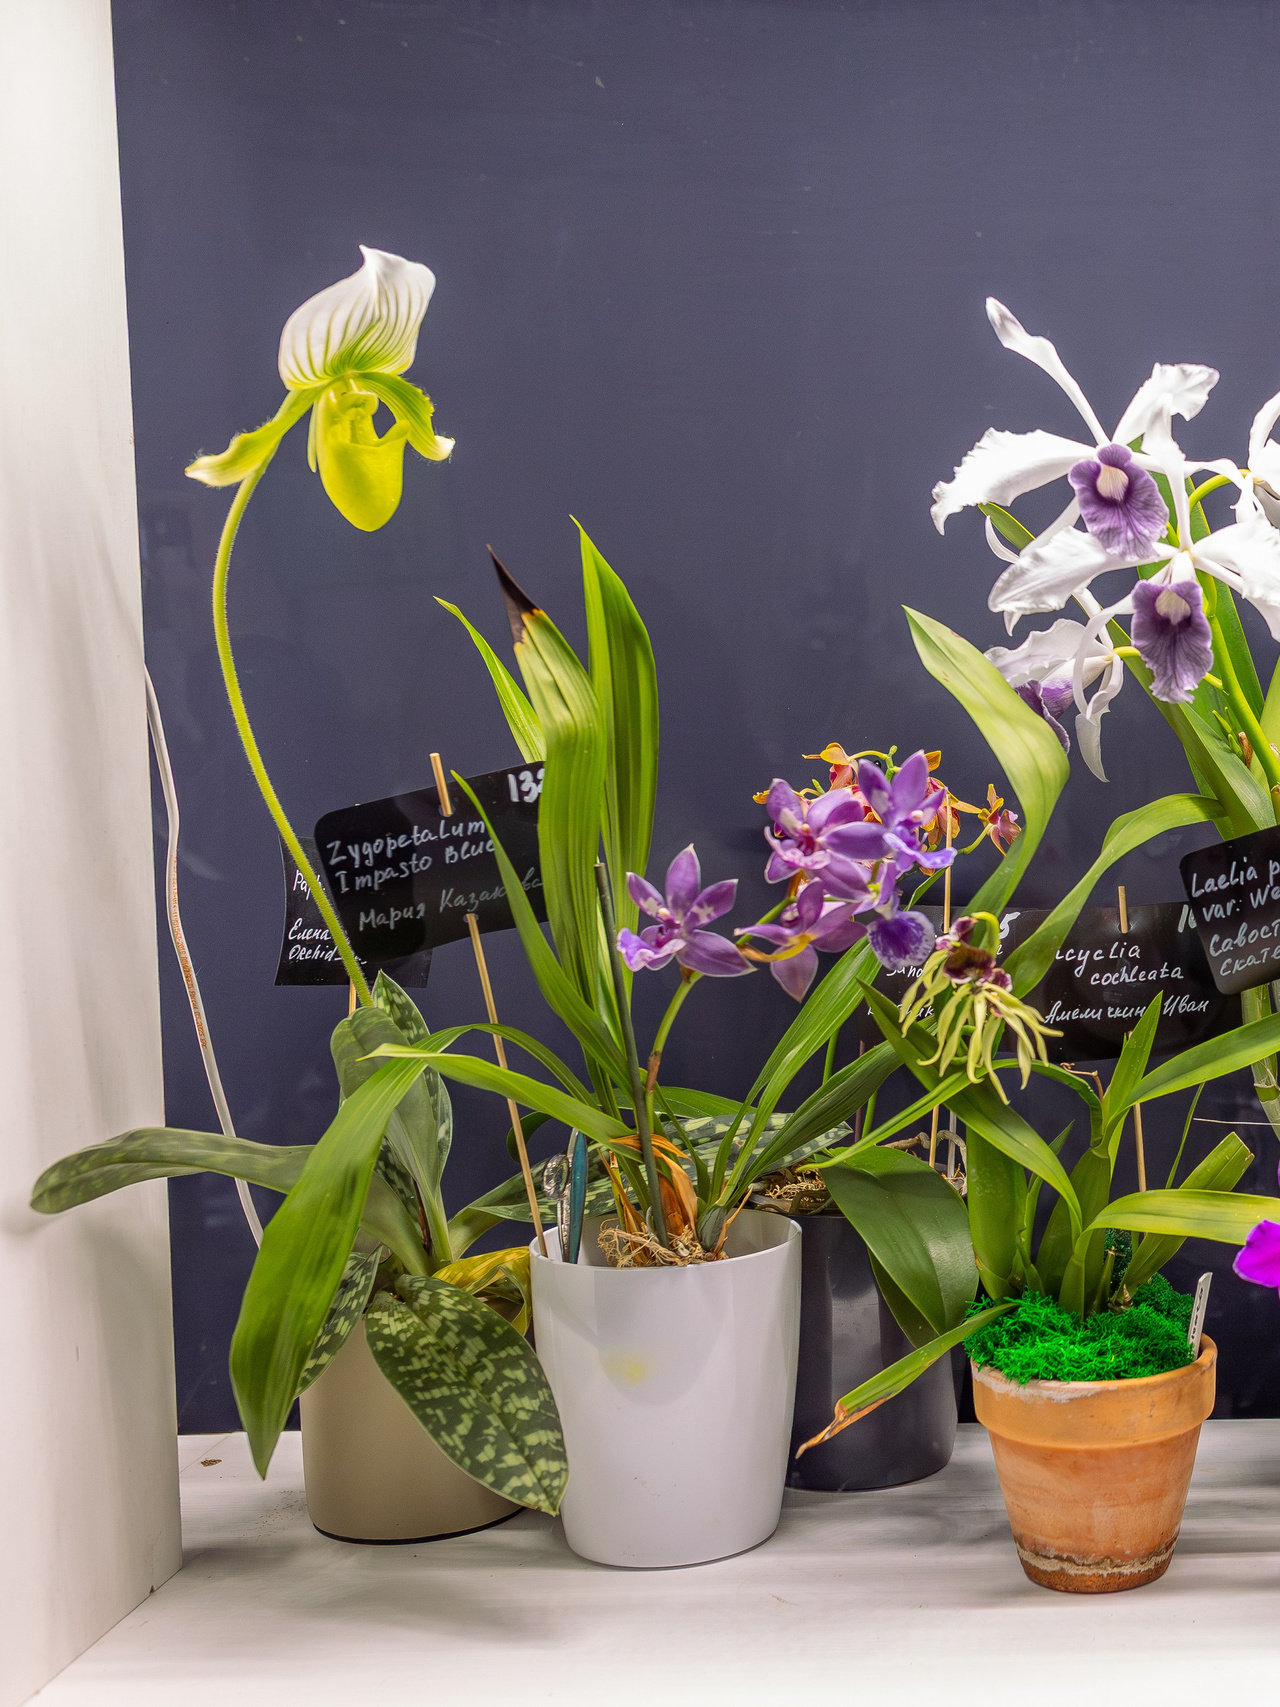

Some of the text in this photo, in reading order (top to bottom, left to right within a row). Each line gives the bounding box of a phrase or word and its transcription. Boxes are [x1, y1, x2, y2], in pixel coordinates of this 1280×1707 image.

[359, 866, 544, 931] Мария Казаква
[1090, 962, 1184, 986] cochleata
[1162, 994, 1210, 1016] Иван
